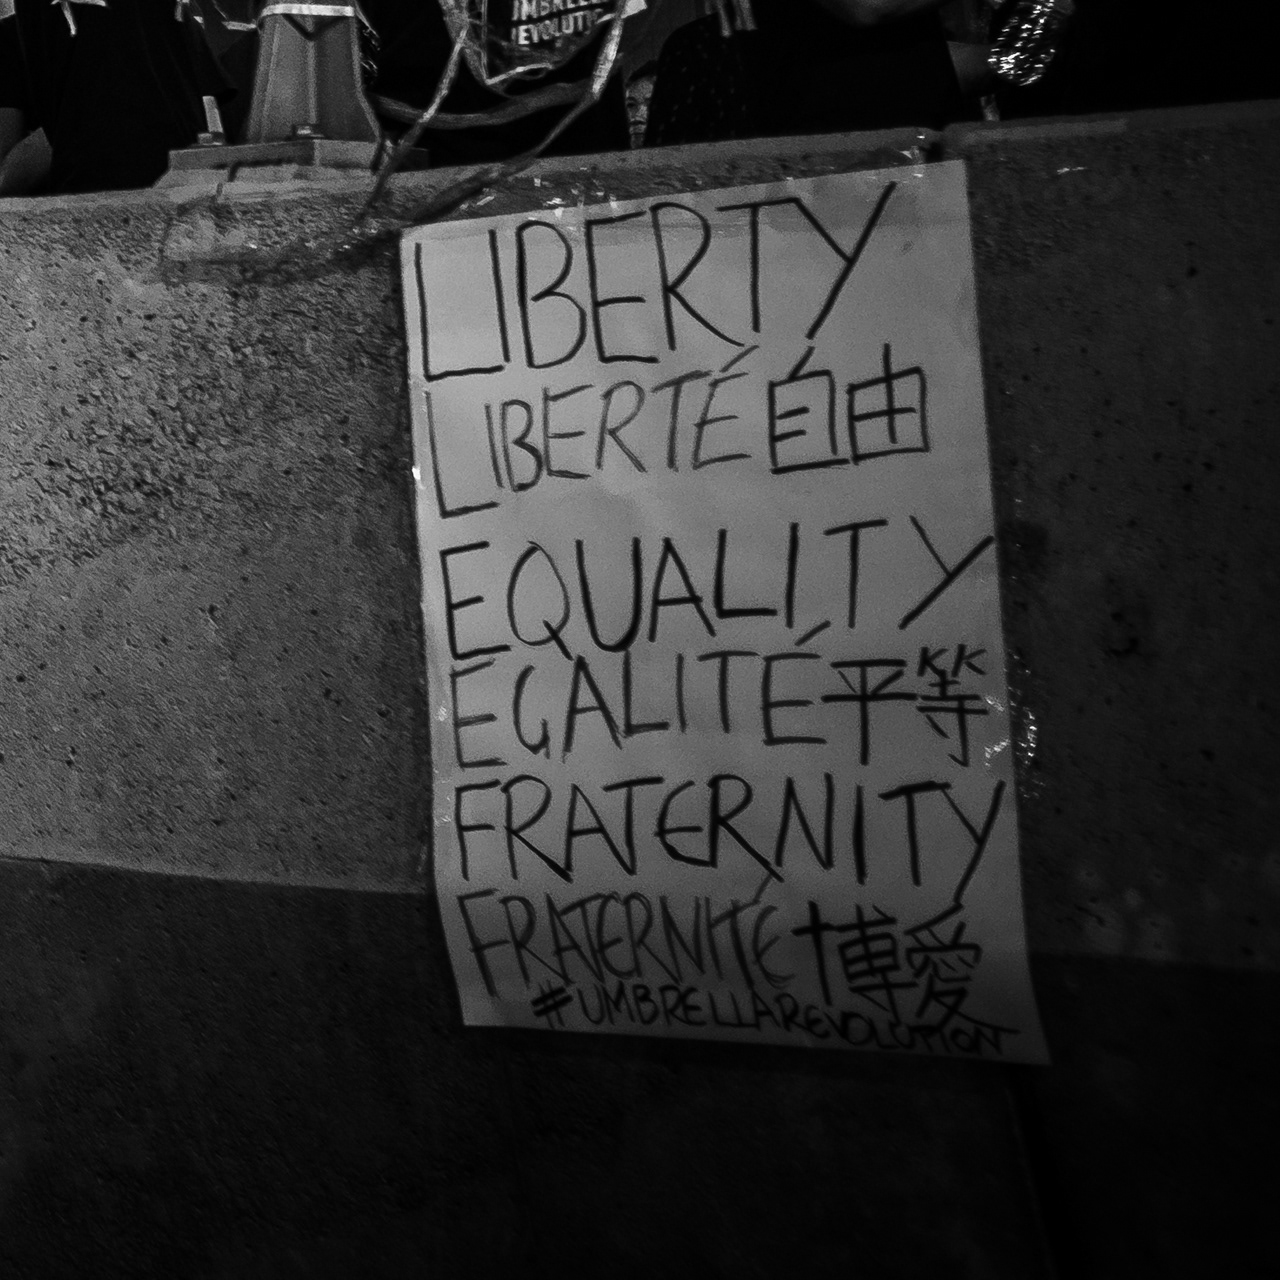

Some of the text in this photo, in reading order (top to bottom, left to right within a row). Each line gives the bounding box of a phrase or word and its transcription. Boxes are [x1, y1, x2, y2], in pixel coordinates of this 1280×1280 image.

[415, 181, 897, 382] LIBERTY
[425, 343, 930, 518] LIBERTÉ 自由
[440, 515, 995, 660] EQUALITY
[822, 645, 989, 768] 平等
[454, 772, 1006, 904] FRATERNITY
[458, 873, 794, 999] FRATERNITÉ
